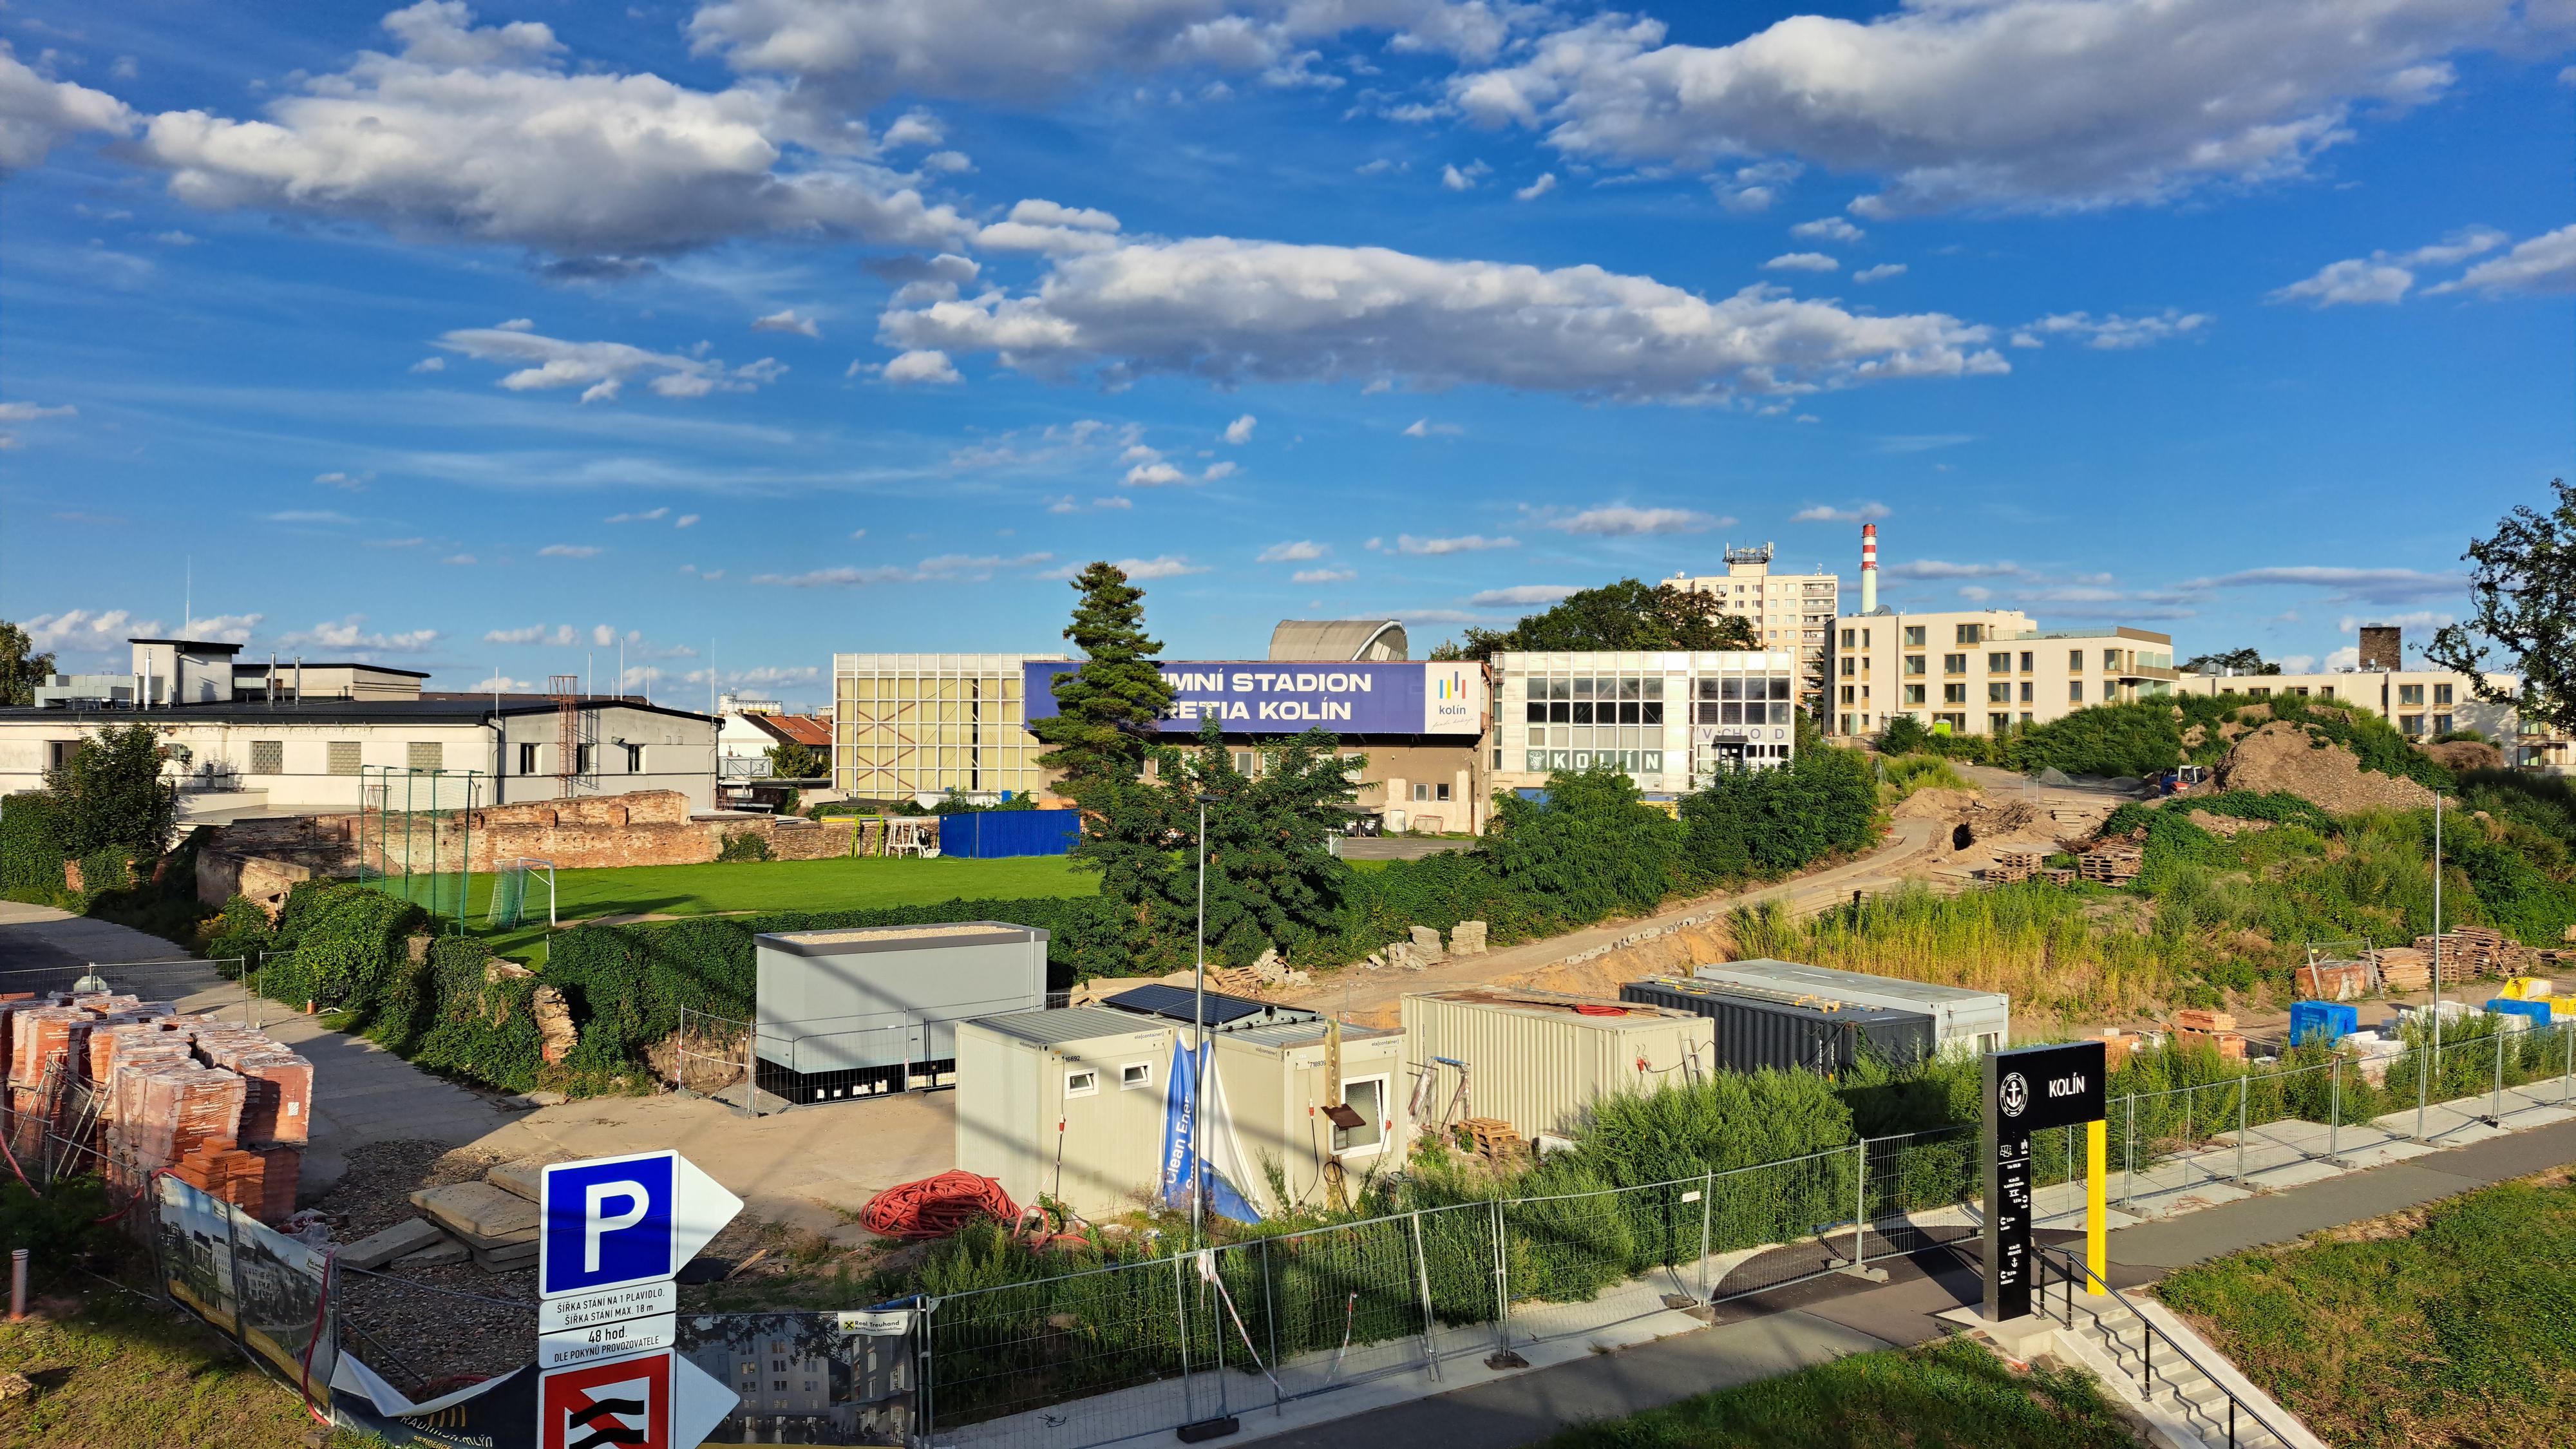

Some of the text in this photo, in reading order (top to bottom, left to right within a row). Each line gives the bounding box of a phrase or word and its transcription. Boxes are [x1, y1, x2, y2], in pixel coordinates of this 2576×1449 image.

[1233, 673, 1371, 692] STADION
[1259, 696, 1351, 720] KOLÍN
[1439, 704, 1466, 715] kolín
[1553, 750, 1659, 770] KOLÍN
[1309, 1059, 1326, 1068] 718939
[2049, 1072, 2085, 1098] KOLÍN
[1166, 1093, 1191, 1184] Clean Ener
[584, 1180, 650, 1273] P
[557, 1301, 581, 1314] ŠÍŘKA
[583, 1296, 605, 1309] STÁNÍ
[607, 1296, 618, 1305] NA
[626, 1288, 665, 1302] PLAVIDLO.
[565, 1313, 589, 1325] ŠÍŘKA
[591, 1307, 613, 1321] STÁNÍ
[614, 1306, 634, 1317] MAX.
[636, 1305, 645, 1313] 18
[588, 1325, 628, 1343] 48 hod.
[554, 1336, 659, 1362] DLE POKYNŮ PROVOZOVATELE
